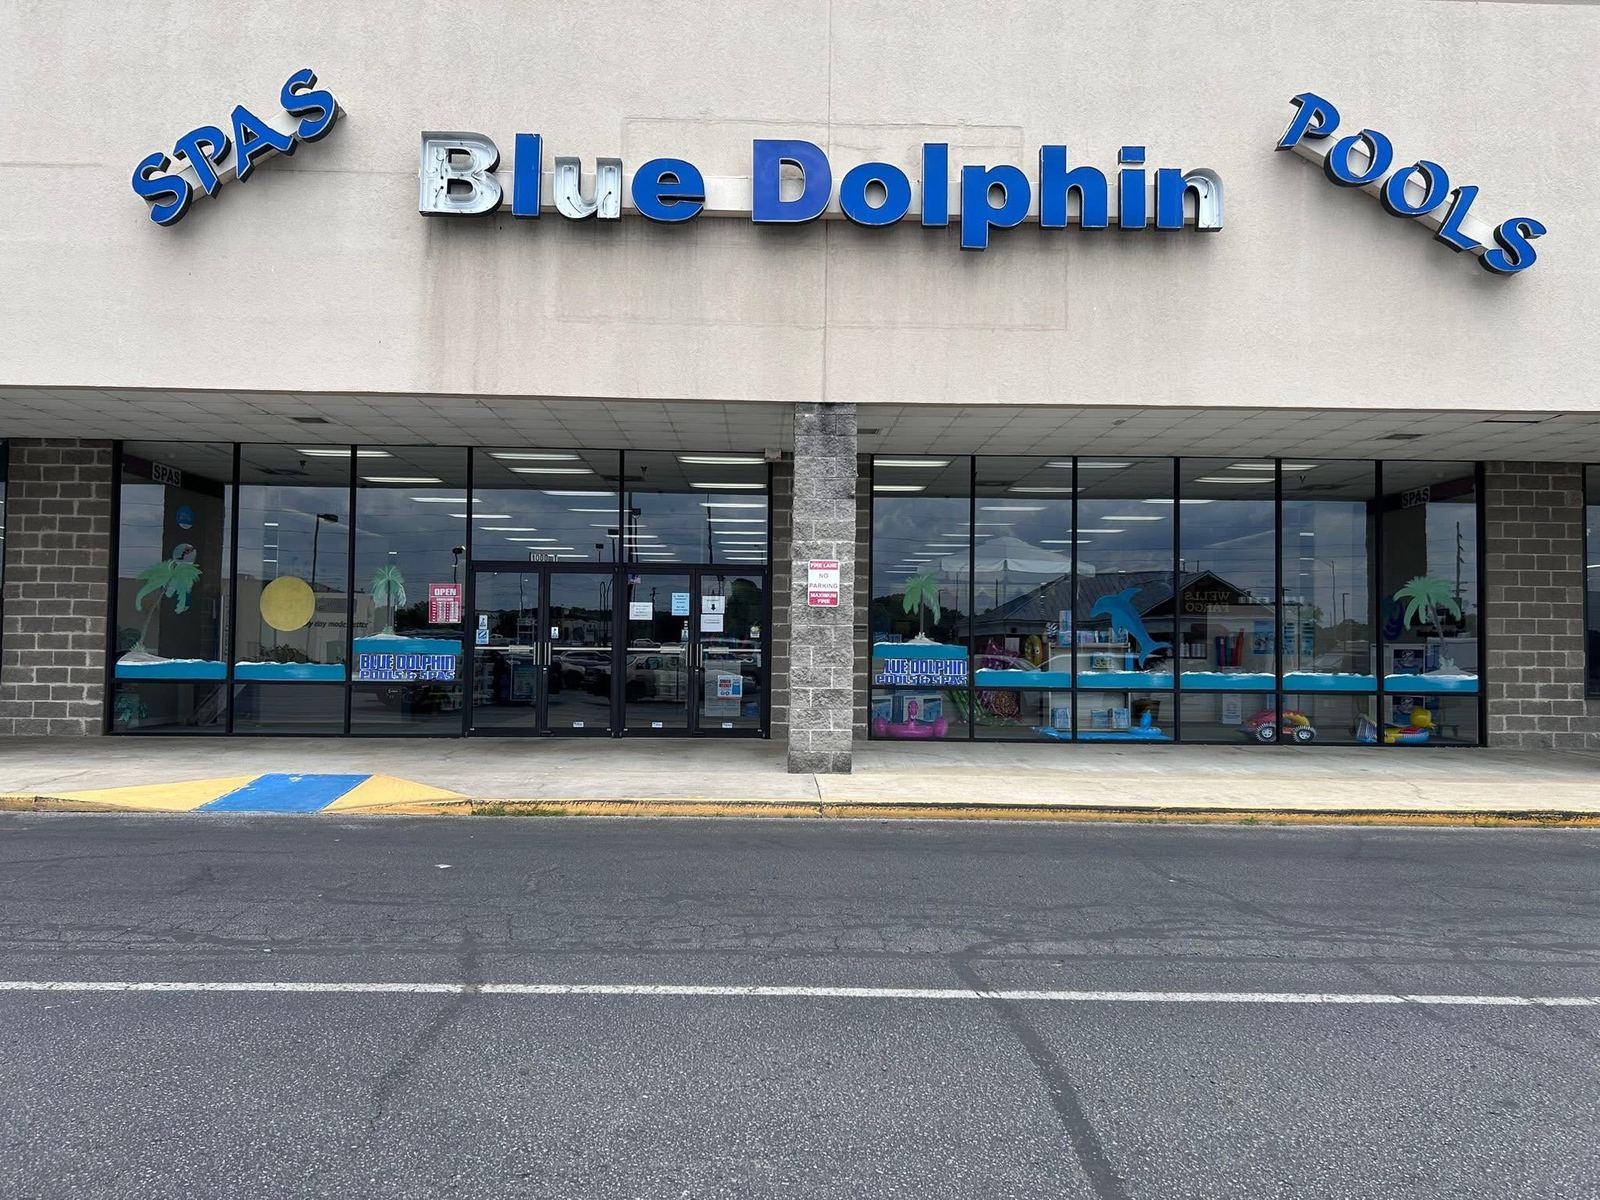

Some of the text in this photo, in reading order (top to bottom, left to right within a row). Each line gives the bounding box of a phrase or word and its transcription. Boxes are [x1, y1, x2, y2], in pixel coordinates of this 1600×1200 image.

[131, 68, 340, 227] SPAS
[420, 131, 1223, 250] Blue Dolphin
[1276, 92, 1547, 275] POOLS
[153, 463, 181, 486] SPAS
[1401, 487, 1429, 507] SPAS
[434, 588, 457, 596] OPEN
[360, 653, 455, 670] BLUE DOLPHIN
[910, 659, 968, 675] DOLPHIN
[360, 670, 404, 680] POOLS
[419, 671, 455, 680] SPAS
[875, 674, 918, 685] POOLS
[932, 675, 968, 685] SPAS
